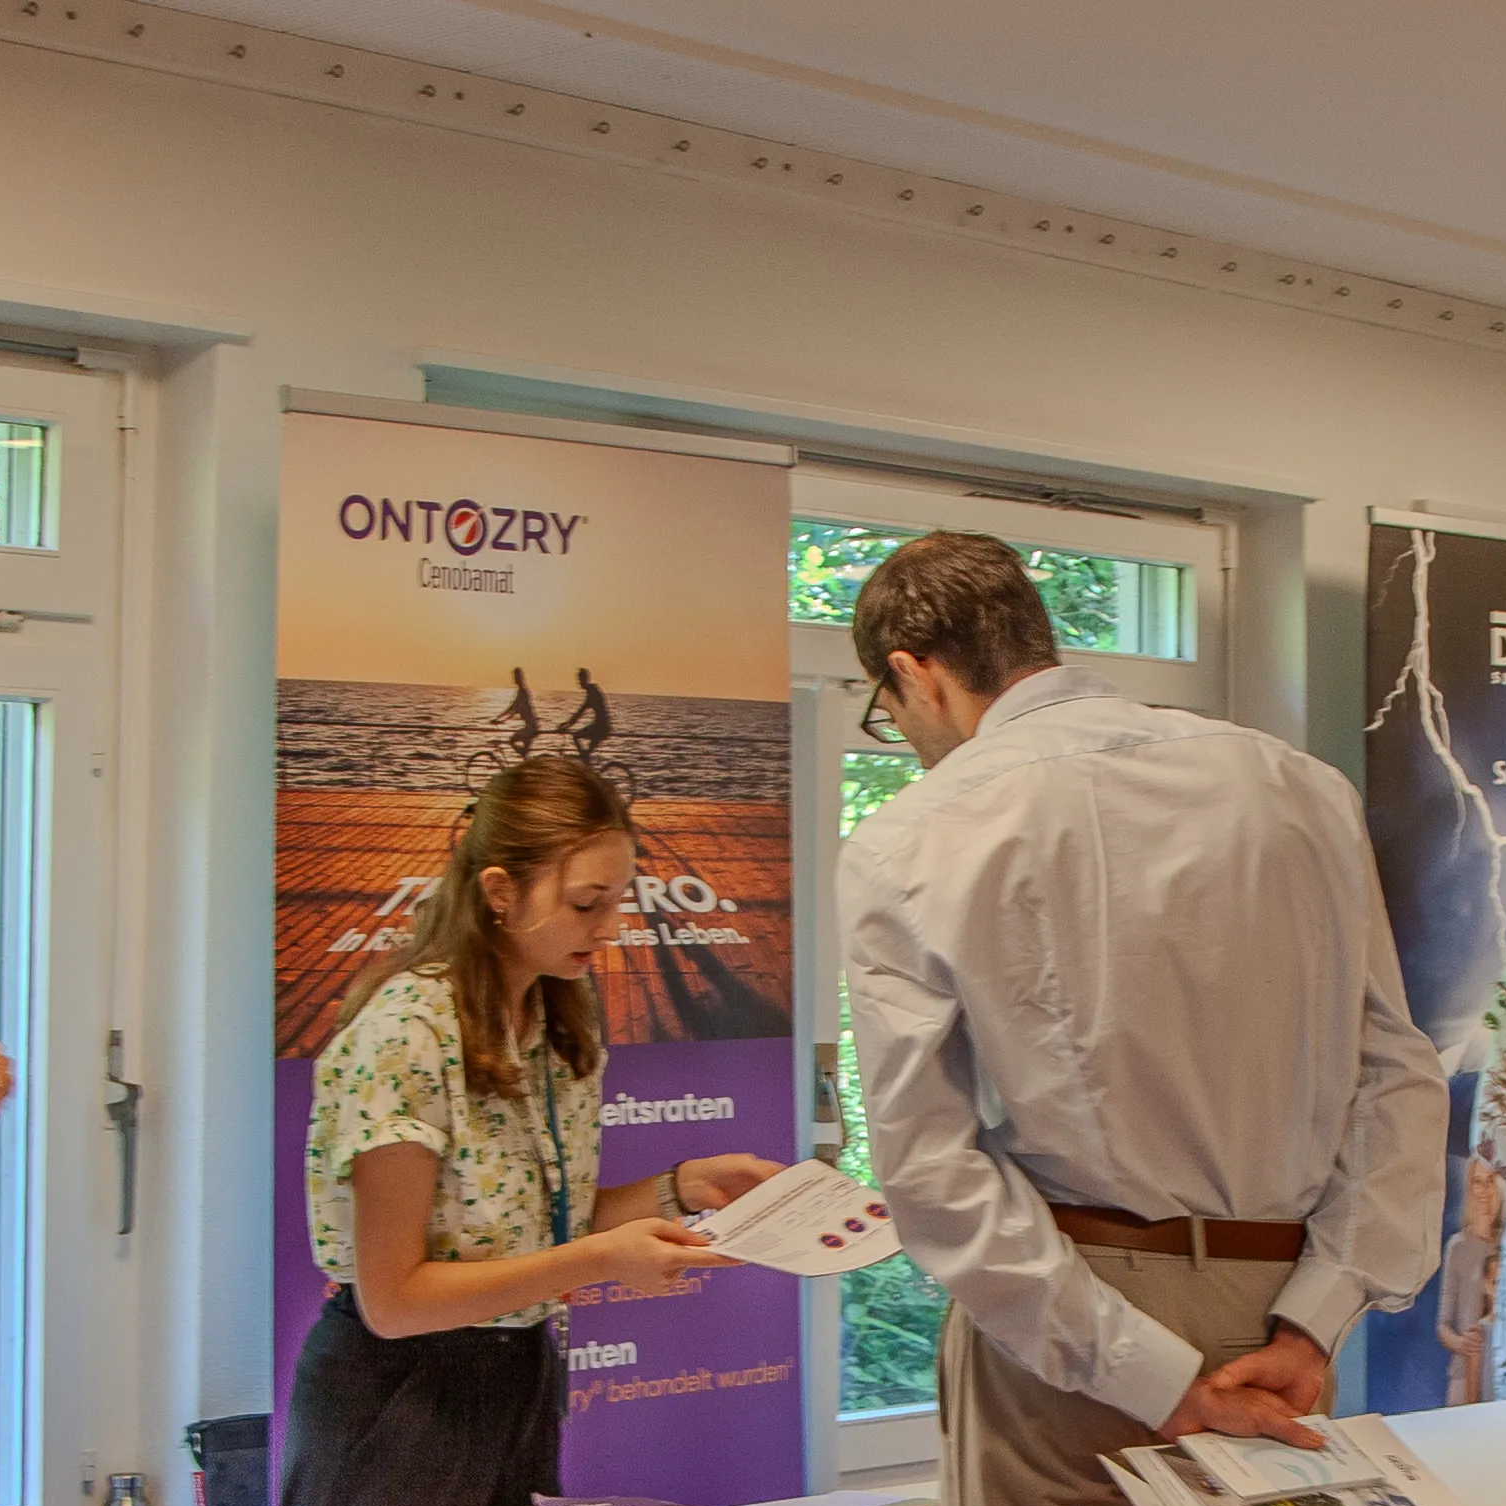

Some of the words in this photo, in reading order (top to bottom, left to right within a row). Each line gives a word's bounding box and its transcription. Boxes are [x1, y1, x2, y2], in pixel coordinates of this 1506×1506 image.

[418, 557, 515, 595] Cenobamat
[325, 928, 368, 952] In
[658, 921, 750, 946] Leben.
[606, 1367, 714, 1403] behandelt
